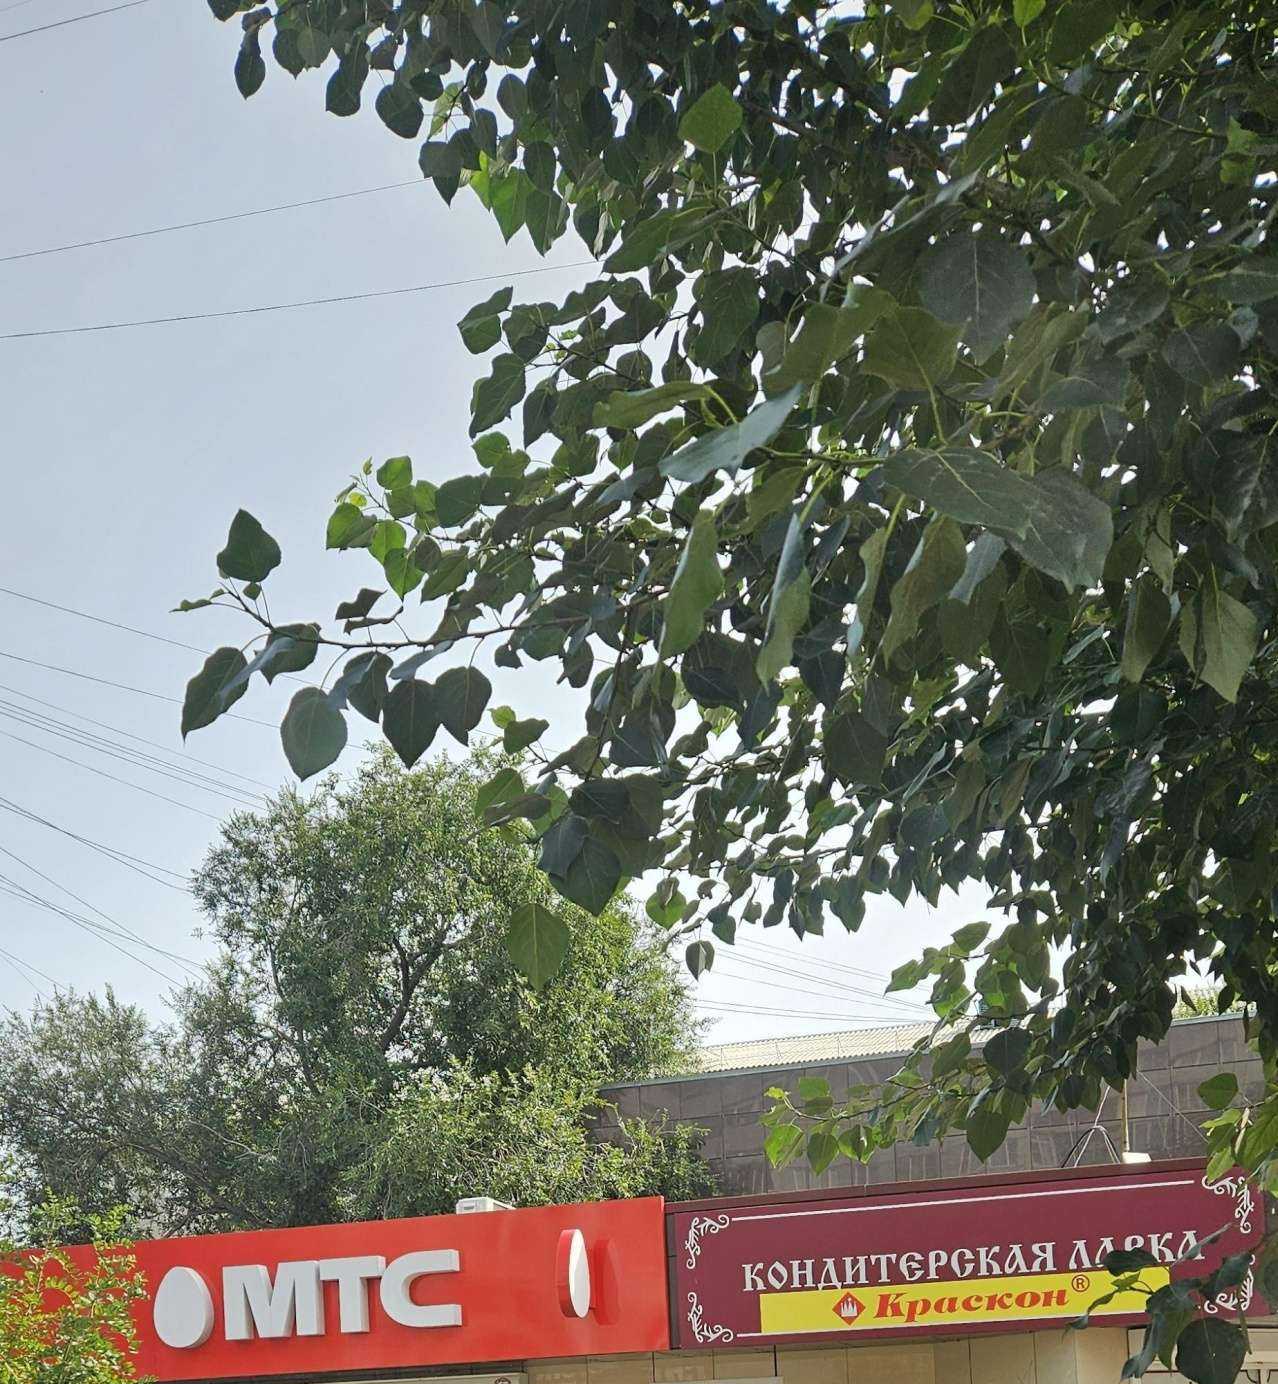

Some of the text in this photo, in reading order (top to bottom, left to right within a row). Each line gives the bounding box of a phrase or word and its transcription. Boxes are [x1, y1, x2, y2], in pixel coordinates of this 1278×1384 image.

[741, 1241, 1055, 1292] КОНДИТЕРСКАЯ
[222, 1249, 463, 1342] МТС
[873, 1288, 1069, 1323] Краскон
